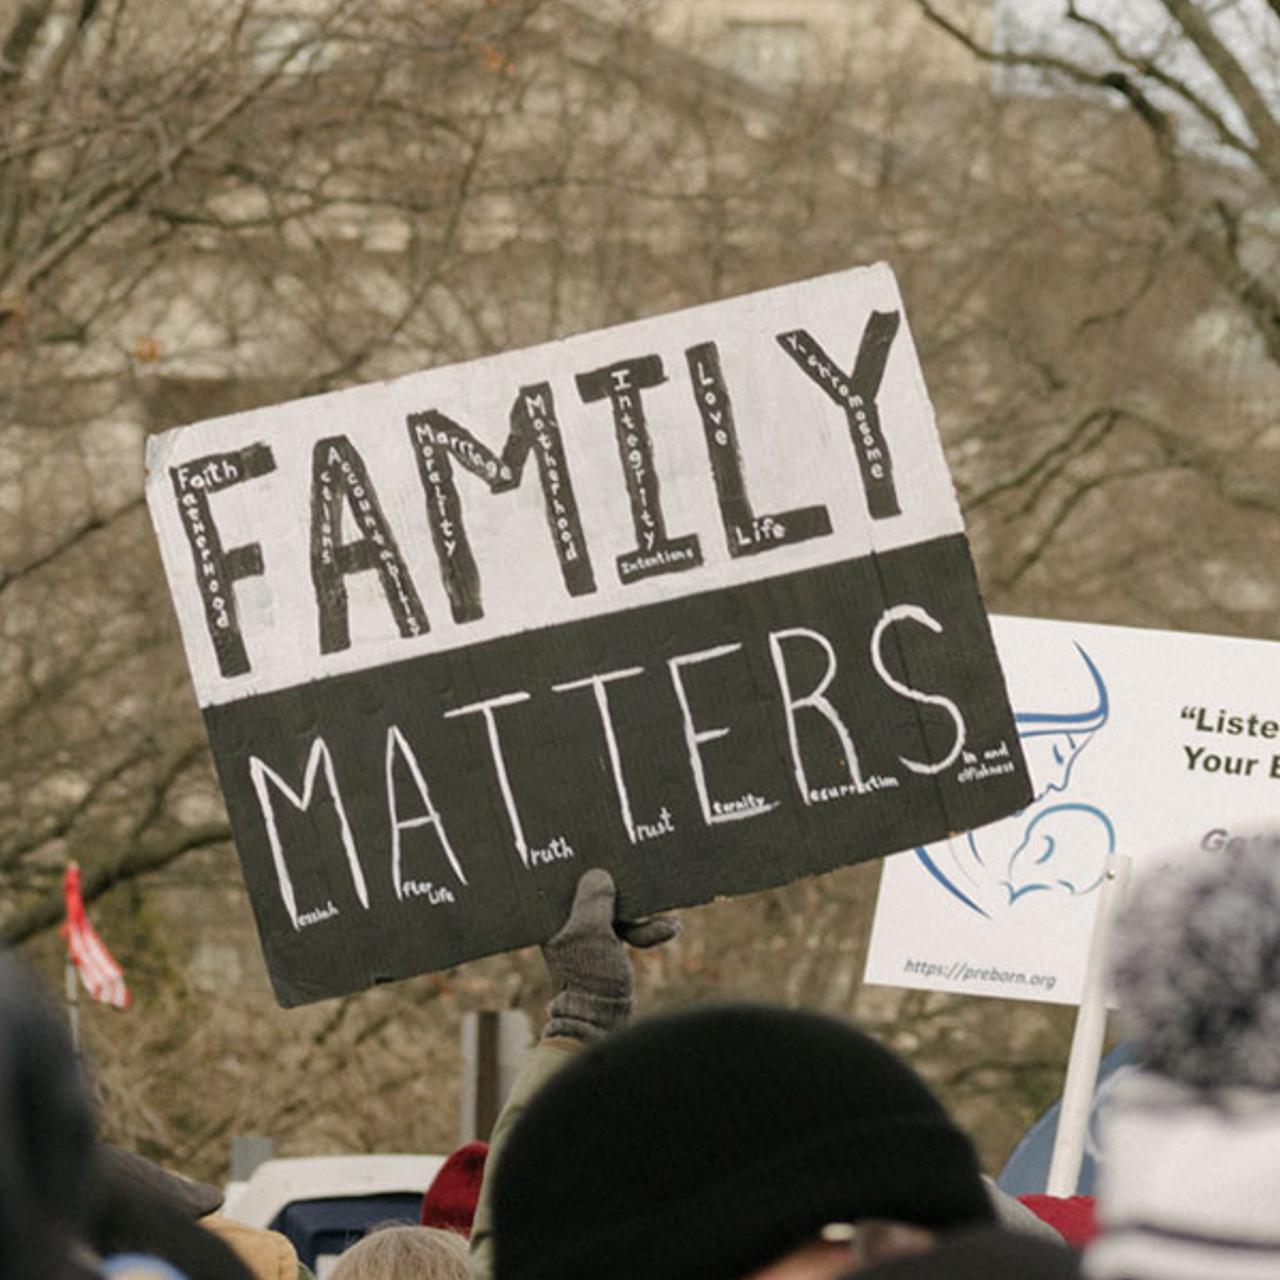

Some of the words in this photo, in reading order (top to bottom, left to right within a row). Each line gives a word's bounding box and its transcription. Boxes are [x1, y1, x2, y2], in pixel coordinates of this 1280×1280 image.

[696, 361, 728, 446] Love
[170, 309, 902, 678] FAMILY
[176, 460, 239, 490] Faith
[524, 394, 578, 561] Motherhood
[610, 369, 655, 551] Integrity
[735, 515, 787, 546] Life
[248, 604, 966, 932] MATTERS
[1183, 745, 1259, 776] Your
[903, 958, 1057, 991] https://preborn.org
